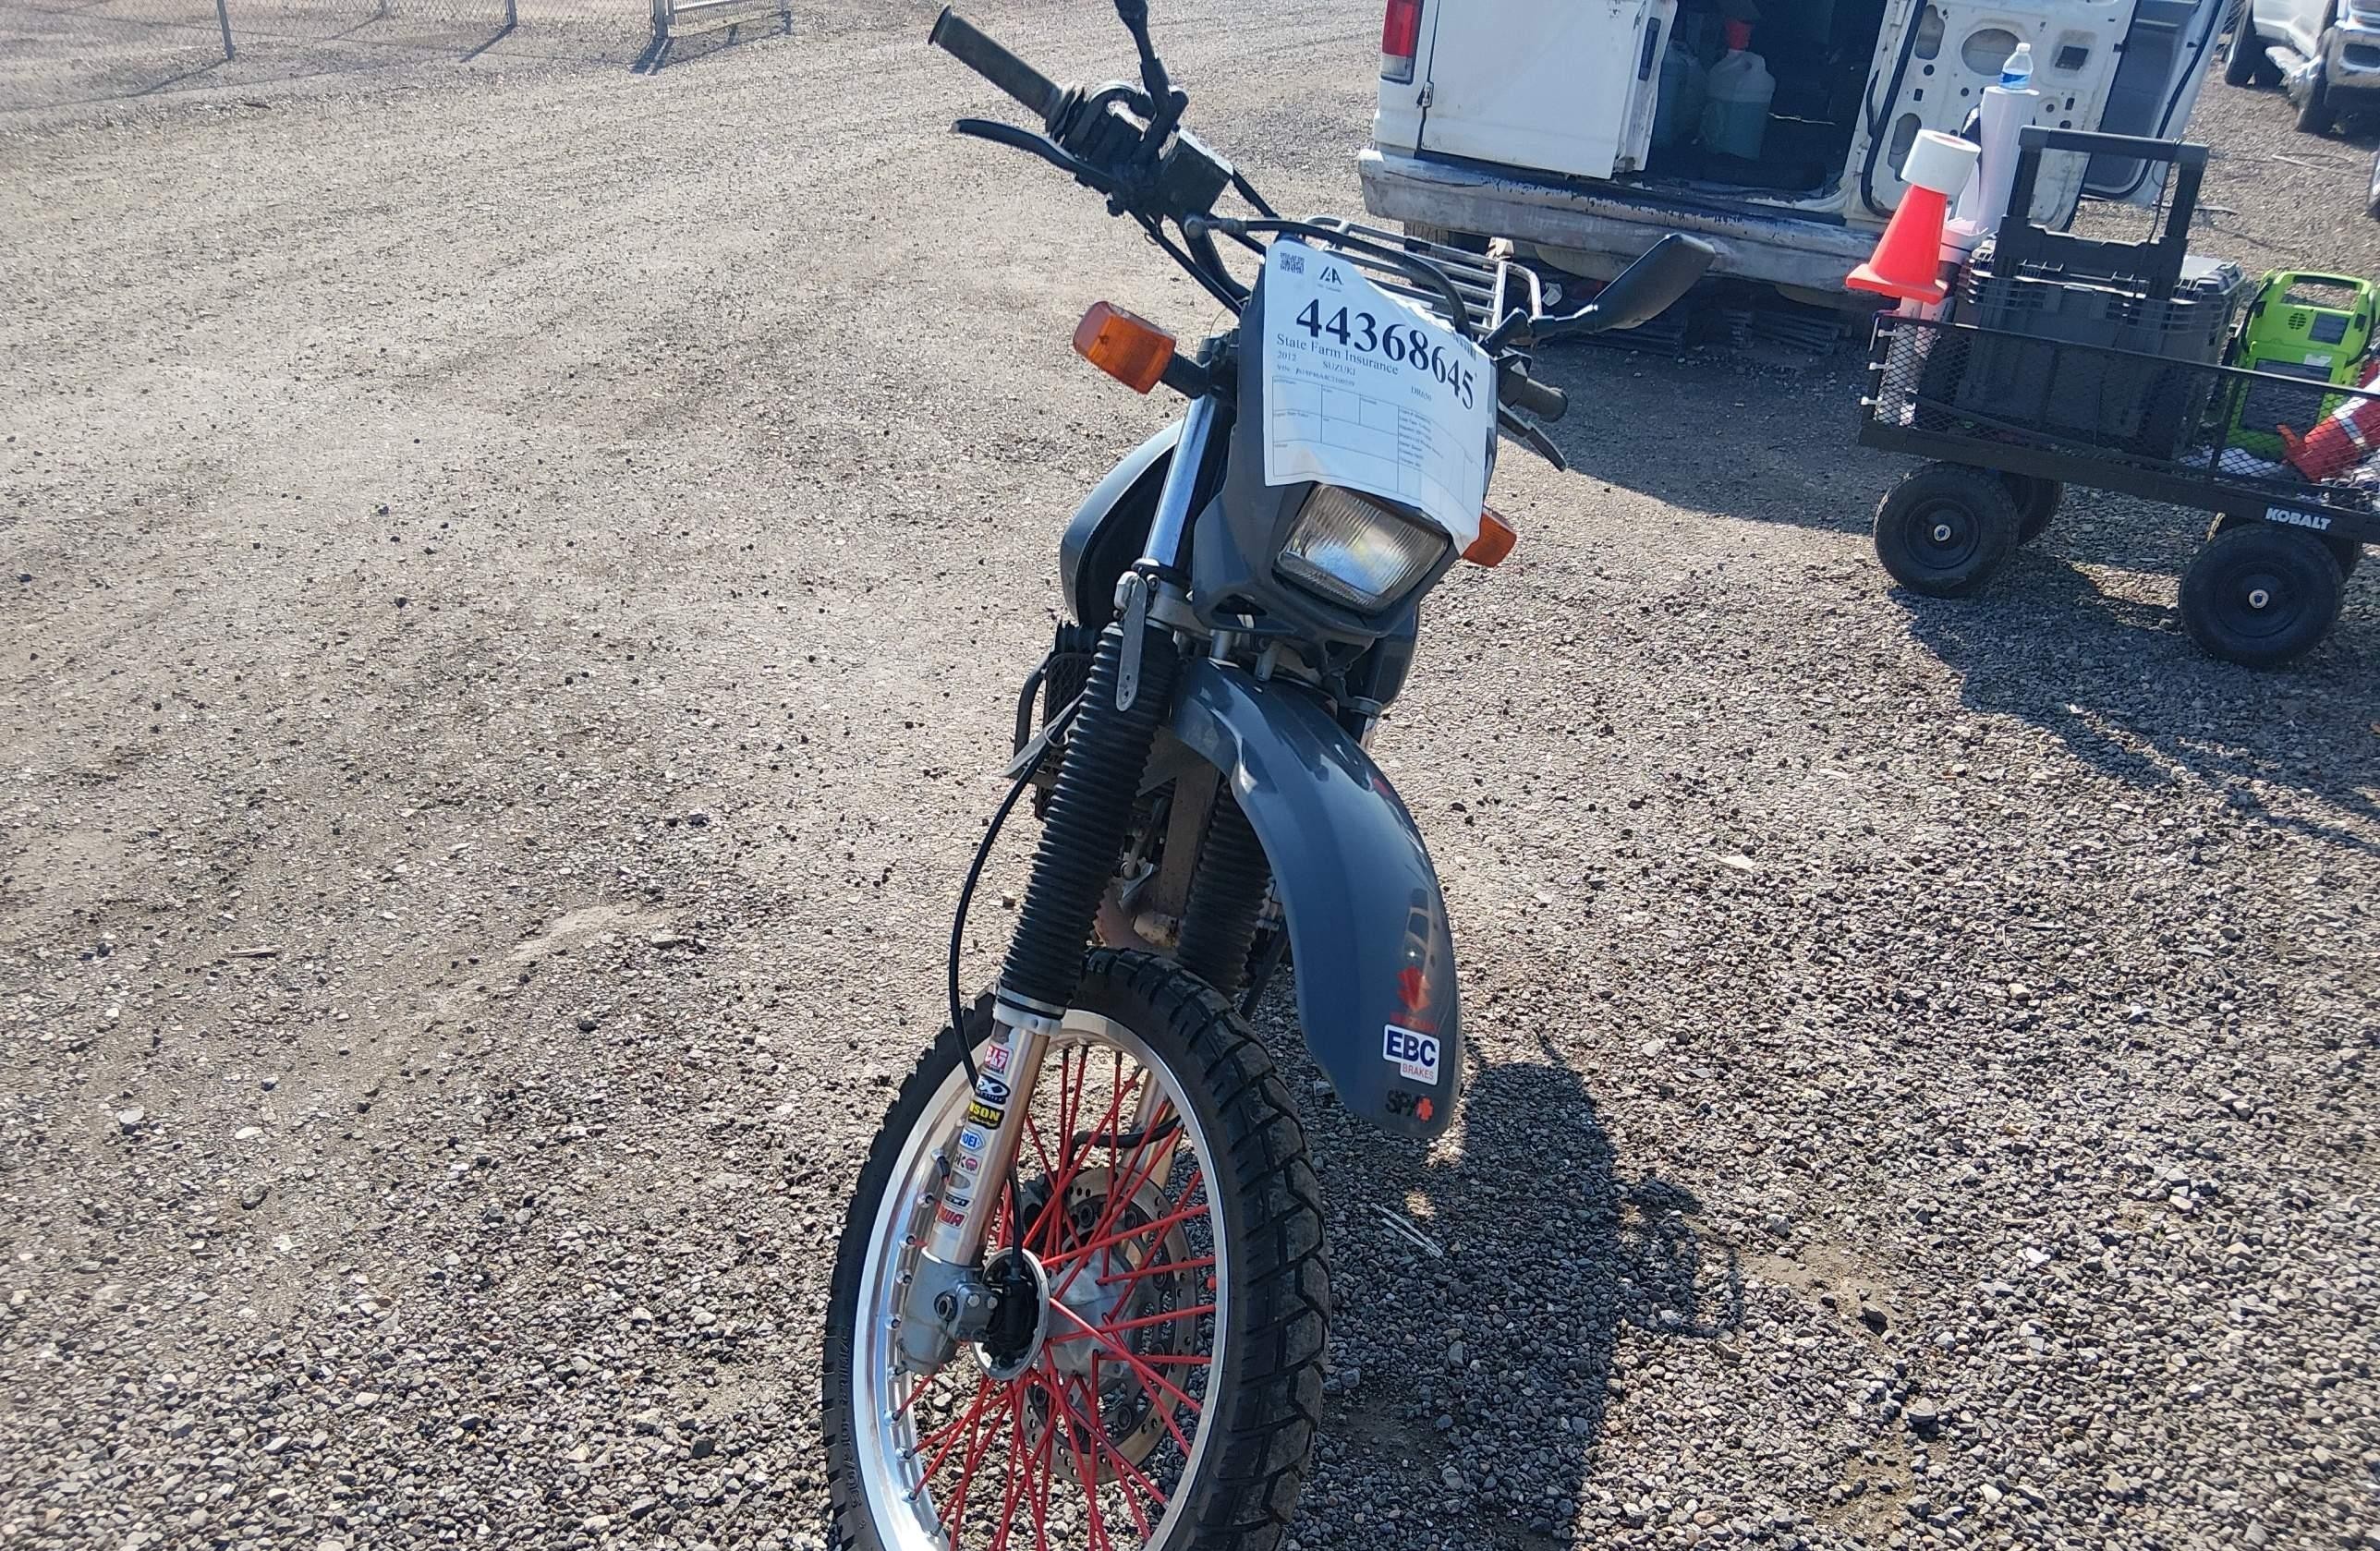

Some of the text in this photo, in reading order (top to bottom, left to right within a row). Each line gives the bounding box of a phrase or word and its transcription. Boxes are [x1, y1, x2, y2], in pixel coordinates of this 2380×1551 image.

[1277, 333, 1399, 375] State Farm Insurance
[1296, 298, 1474, 410] 44368645
[1323, 361, 1355, 376] SUZUKI
[2265, 507, 2332, 530] KOBALT
[1387, 1029, 1436, 1068] EBC
[1402, 1063, 1435, 1080] BRAKES
